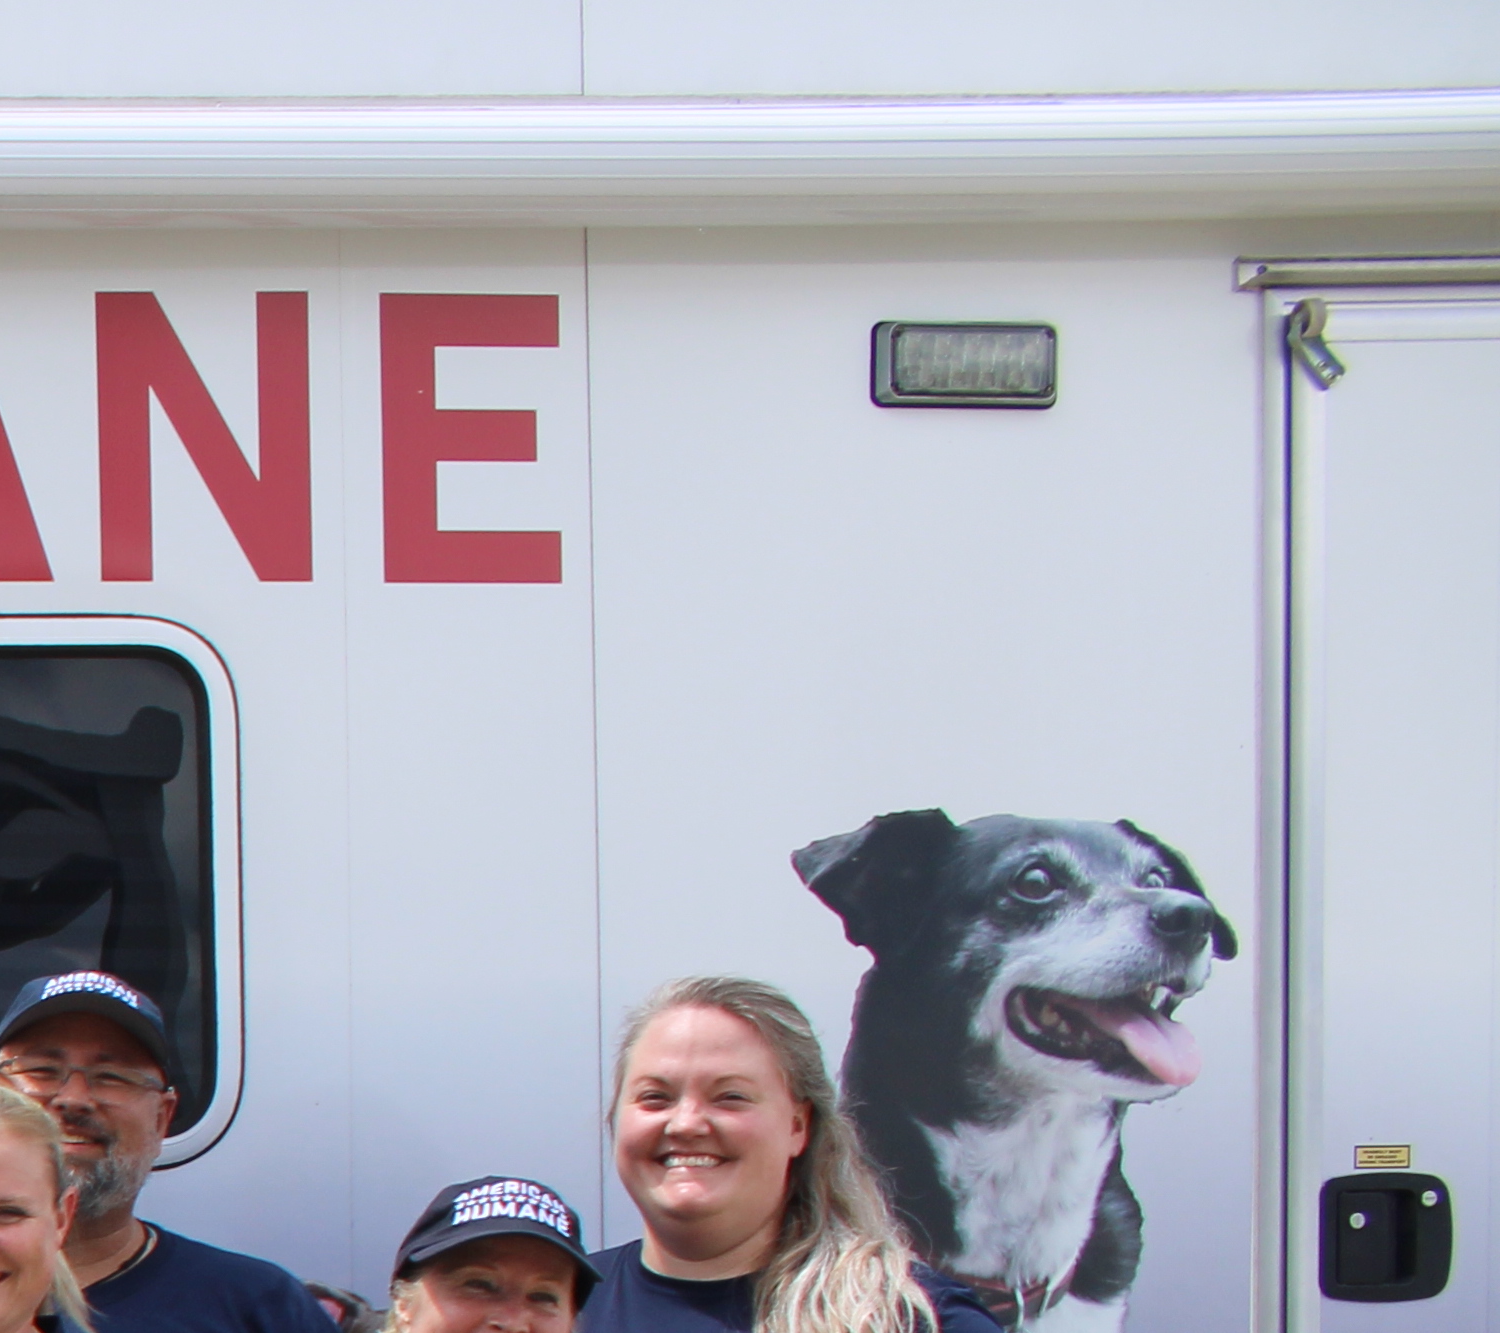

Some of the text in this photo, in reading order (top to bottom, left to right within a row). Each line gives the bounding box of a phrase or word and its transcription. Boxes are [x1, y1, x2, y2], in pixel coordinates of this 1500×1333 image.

[43, 971, 139, 1004] AMERICAN
[453, 1179, 567, 1214] AMERICAN
[451, 1201, 572, 1238] HUMANE
